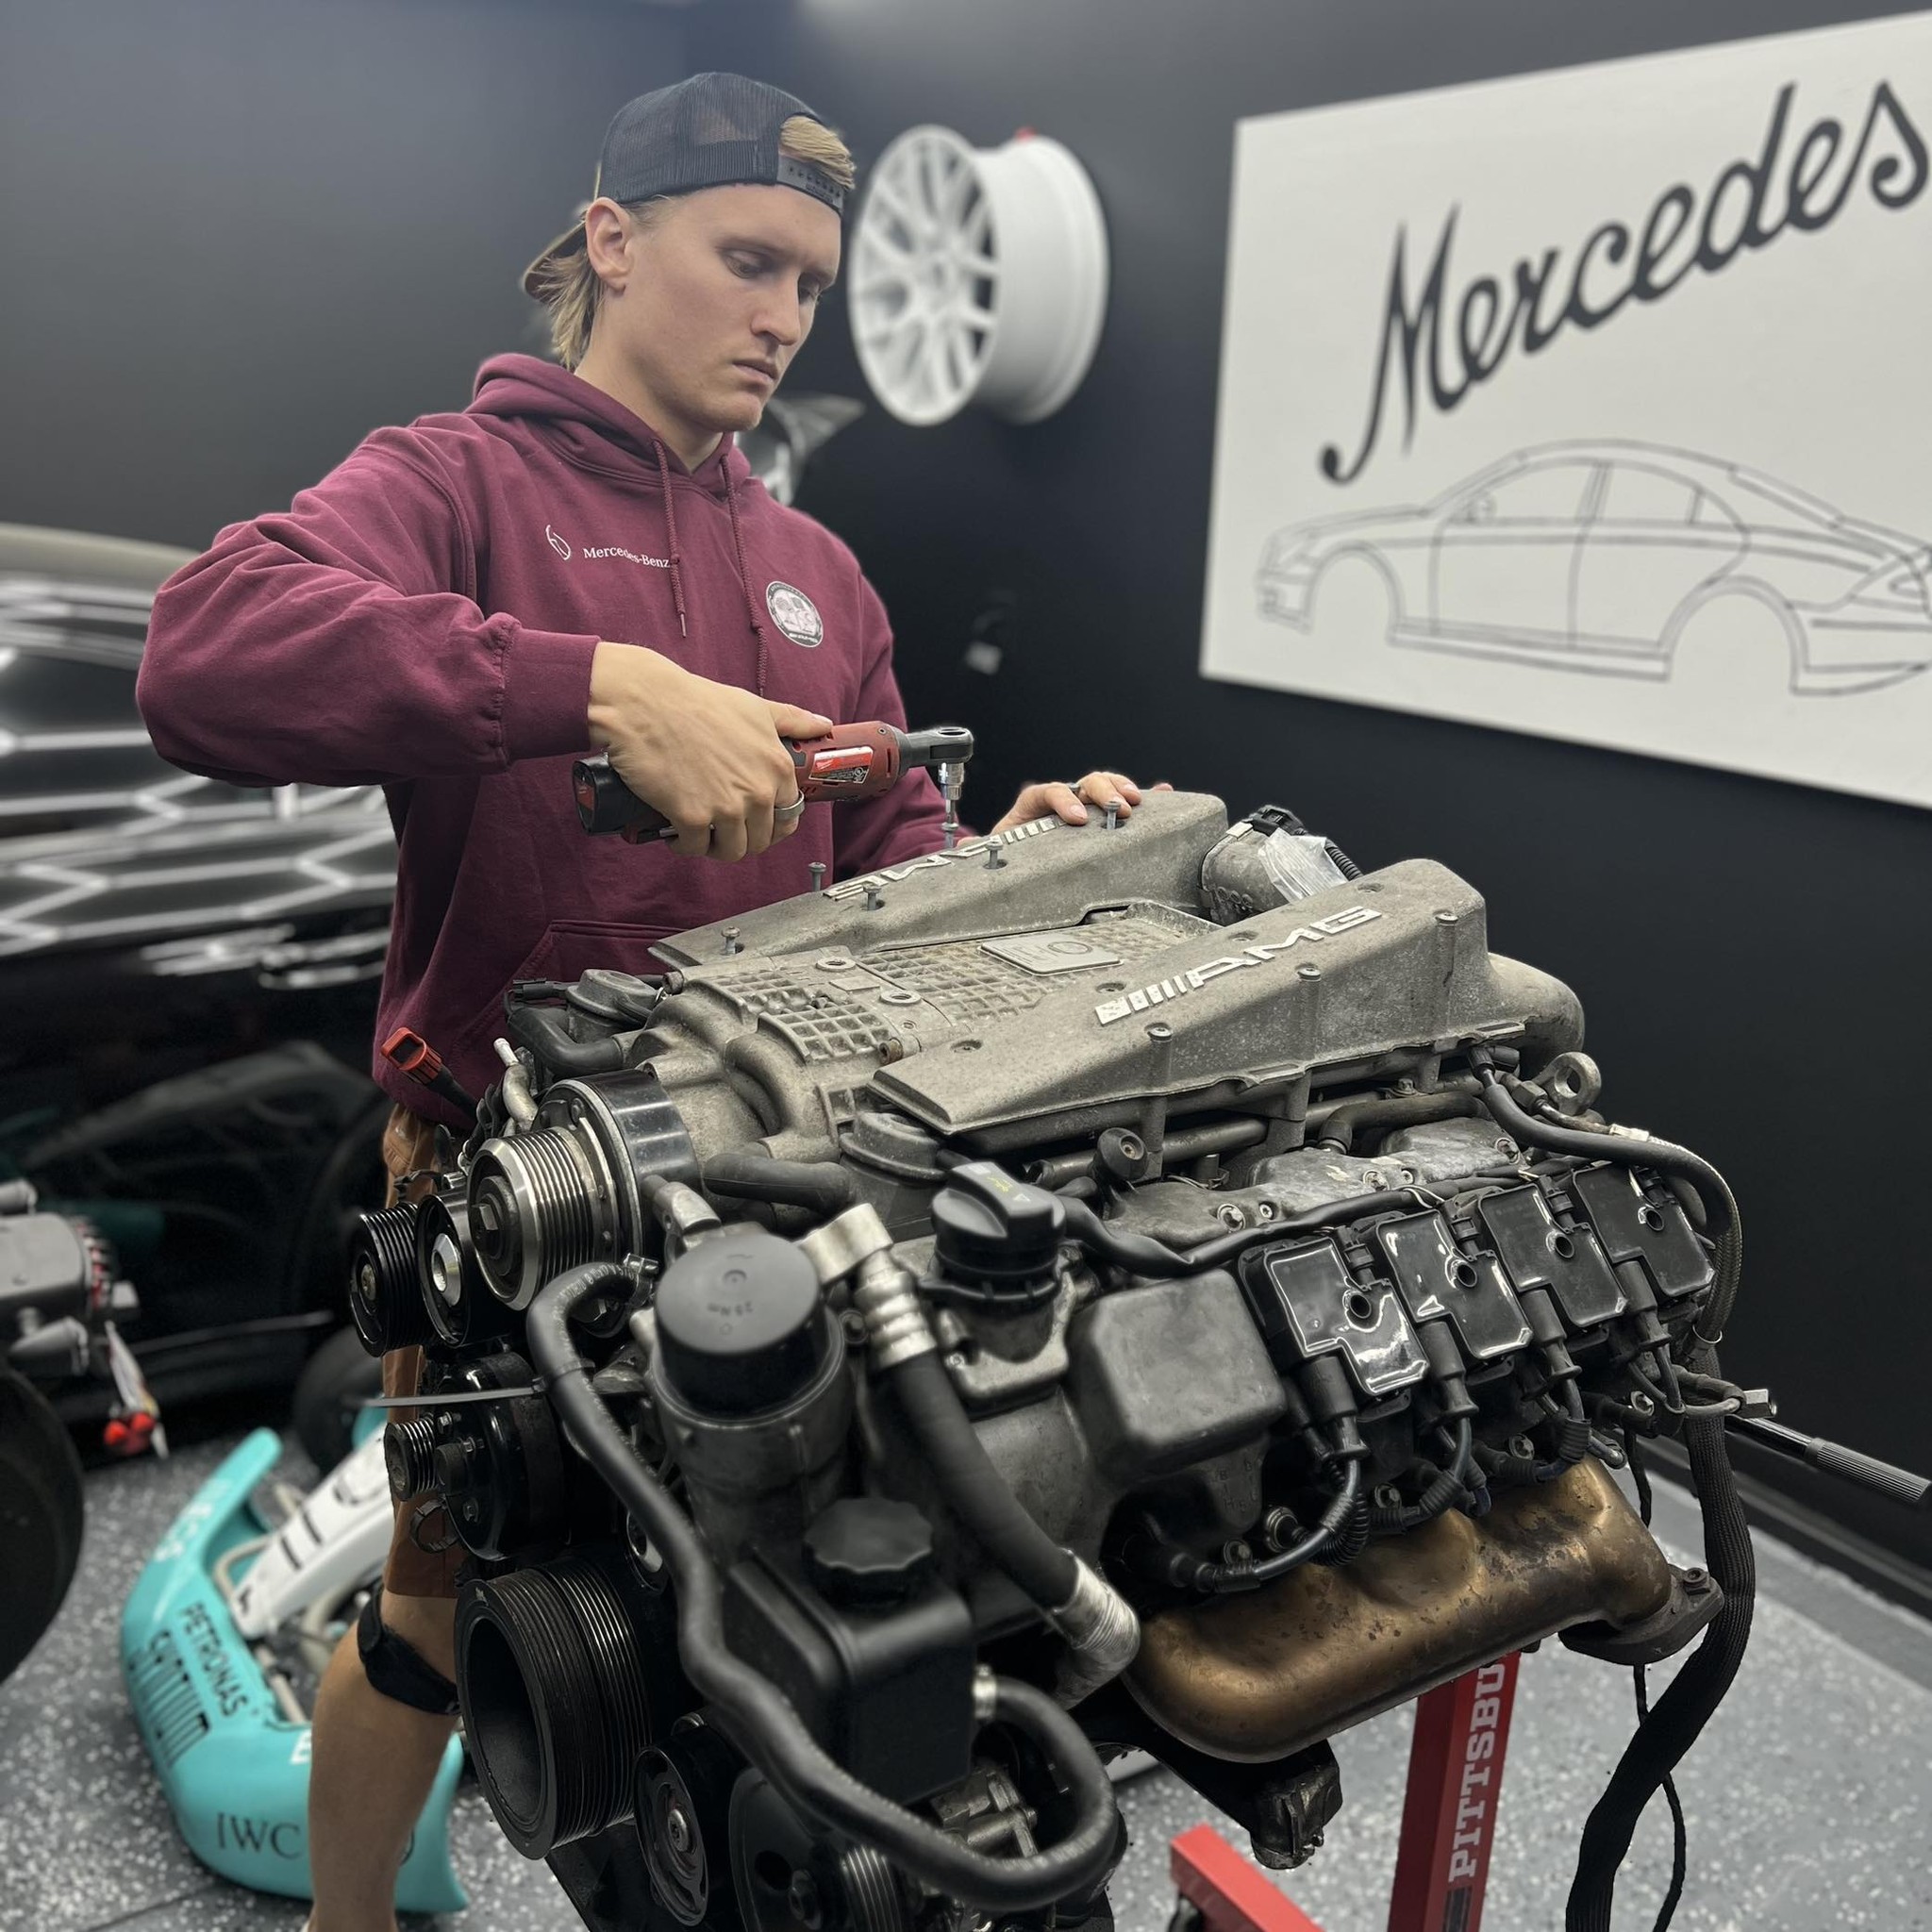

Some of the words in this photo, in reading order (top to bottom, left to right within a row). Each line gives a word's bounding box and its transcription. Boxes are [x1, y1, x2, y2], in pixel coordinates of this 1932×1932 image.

[1319, 79, 1930, 486] Mercedes
[582, 546, 671, 568] Mercedes-Benz
[177, 1601, 248, 1717] PETRONAS
[1448, 1663, 1506, 1883] PITTSBU
[216, 1811, 302, 1860] IWC
